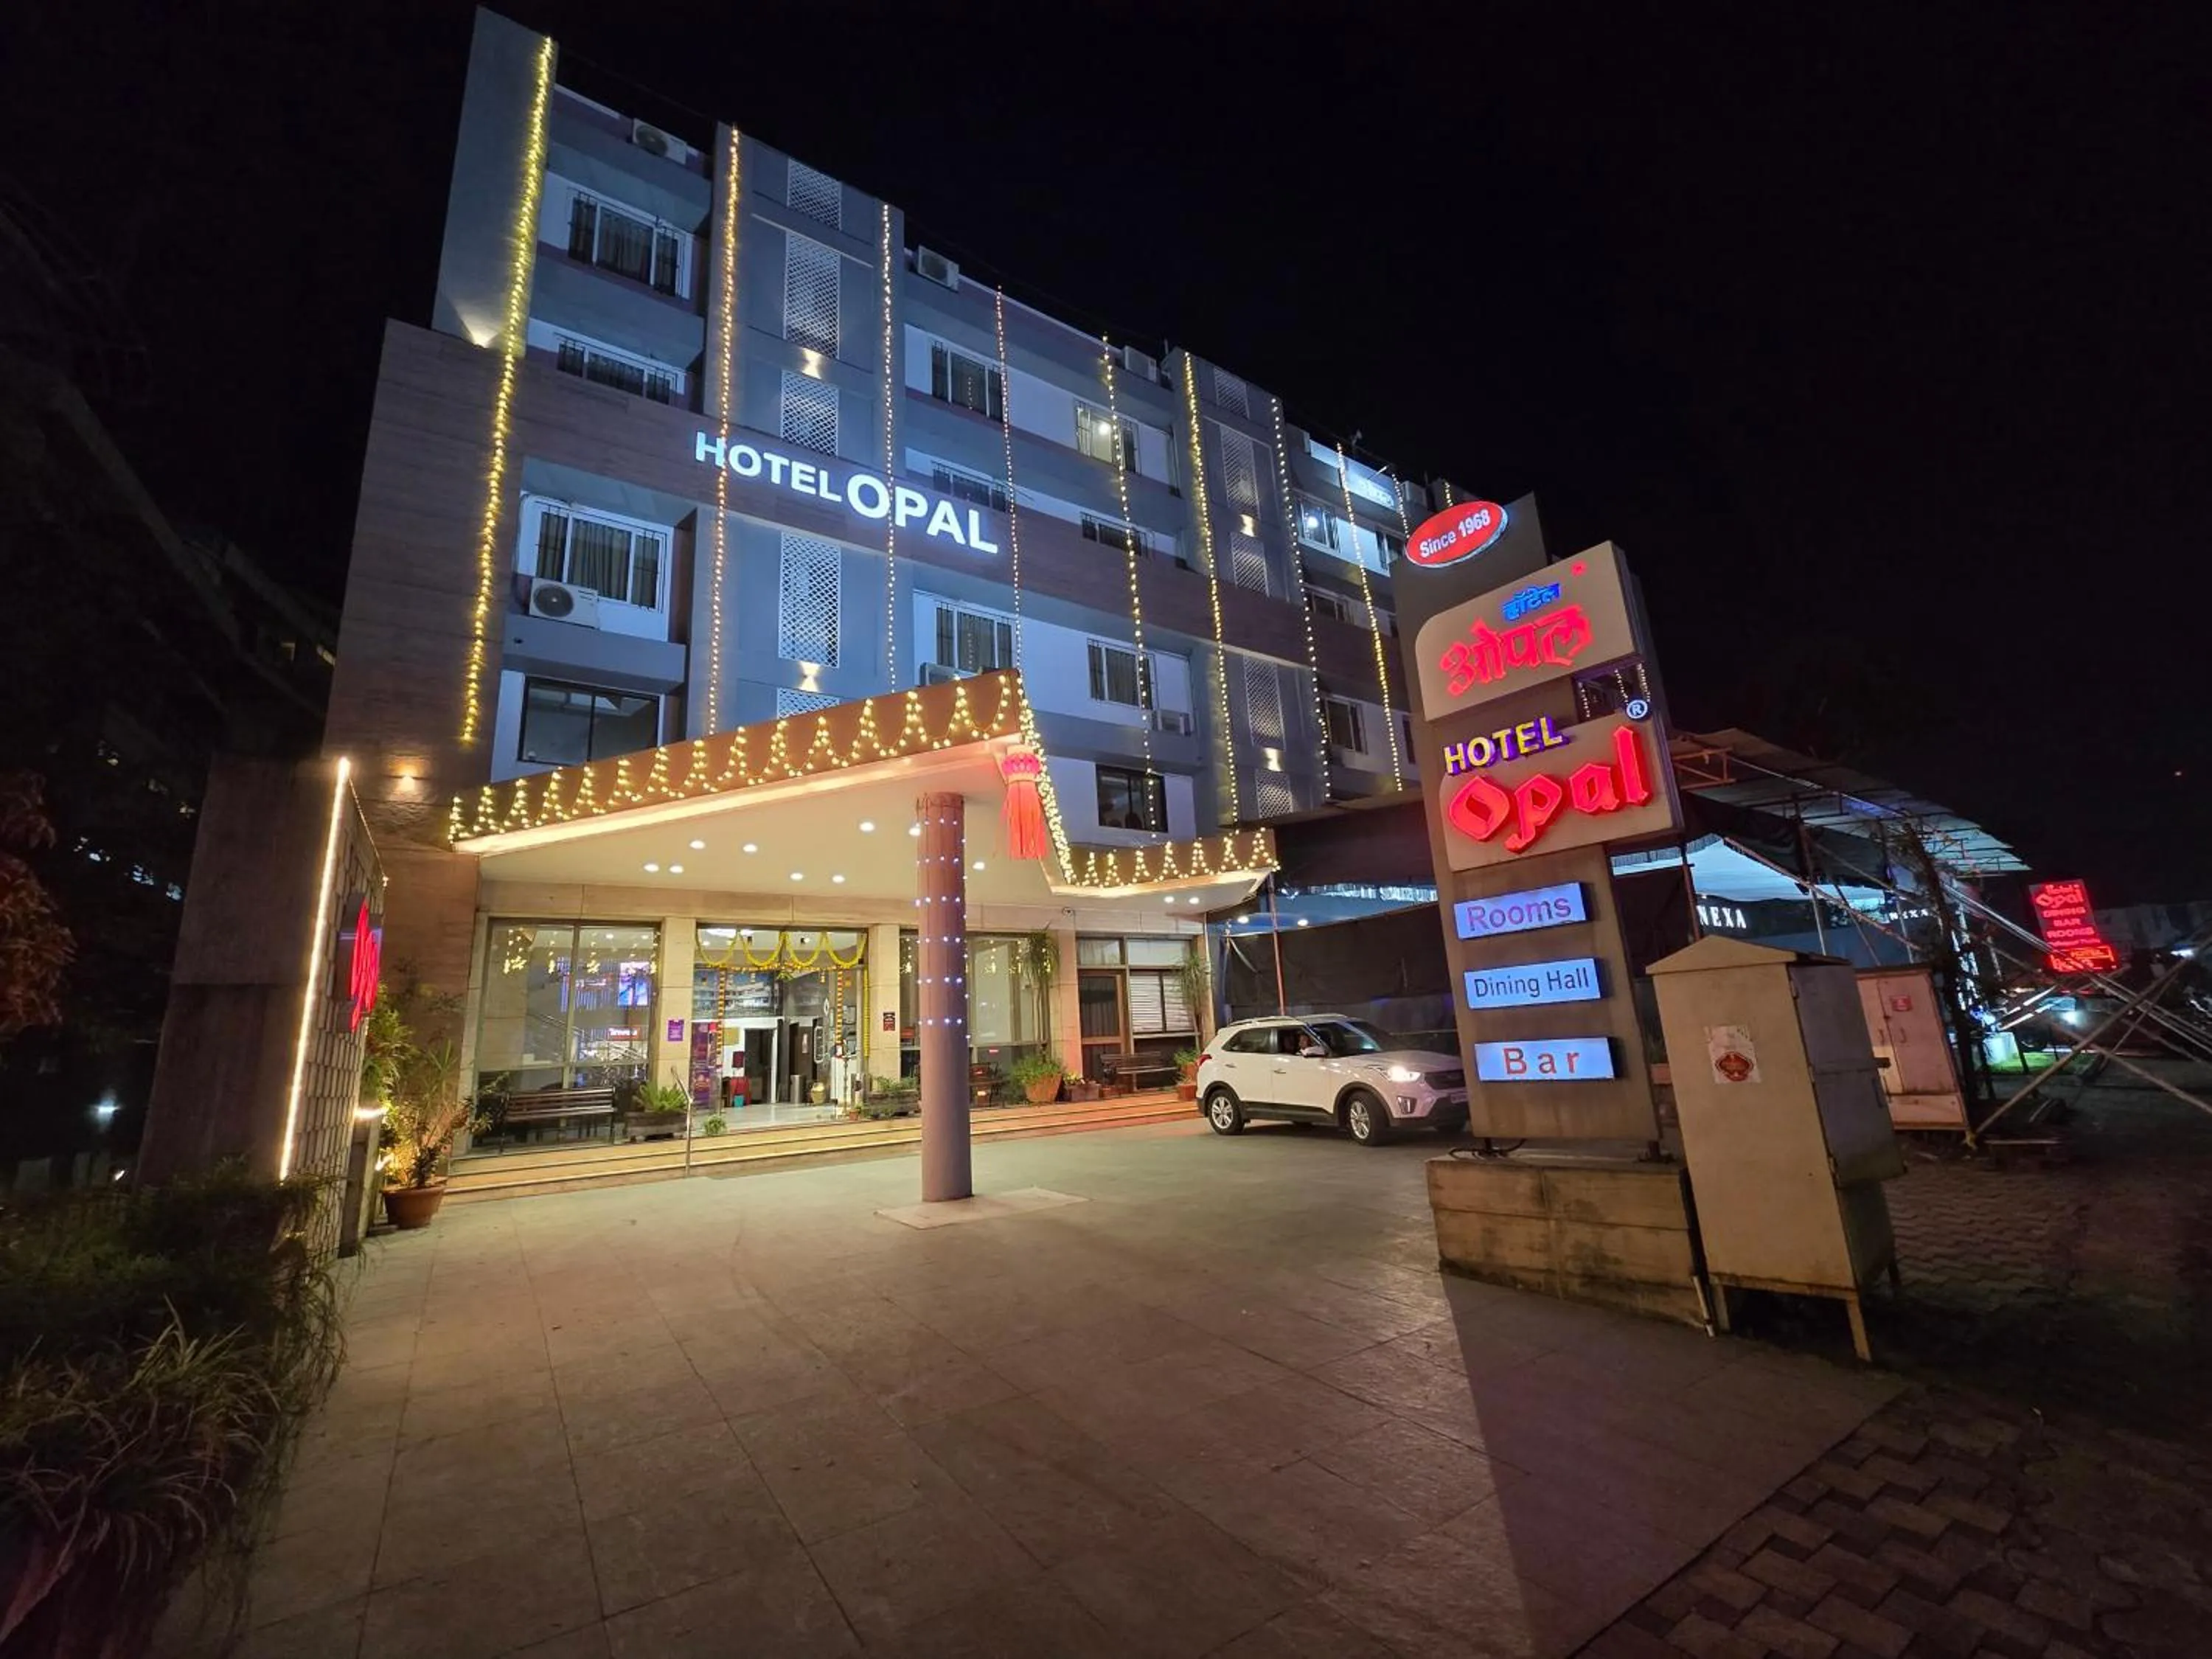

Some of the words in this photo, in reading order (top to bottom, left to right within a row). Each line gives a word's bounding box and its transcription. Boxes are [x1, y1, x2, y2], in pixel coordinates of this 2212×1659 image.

[695, 431, 843, 503] HOTEL
[846, 473, 998, 554] OPAL
[1419, 529, 1457, 559] Since
[1457, 509, 1491, 538] 1968
[1501, 582, 1561, 621] हॉटेल
[1440, 605, 1593, 696] ओपल
[1443, 714, 1566, 775] HOTEL
[1449, 725, 1649, 855] Opal
[1466, 897, 1572, 933] Rooms
[1696, 905, 1747, 929] NEXA
[1473, 974, 1540, 998] Dining
[1546, 966, 1590, 992] Hall
[1501, 1047, 1580, 1075] Bar
